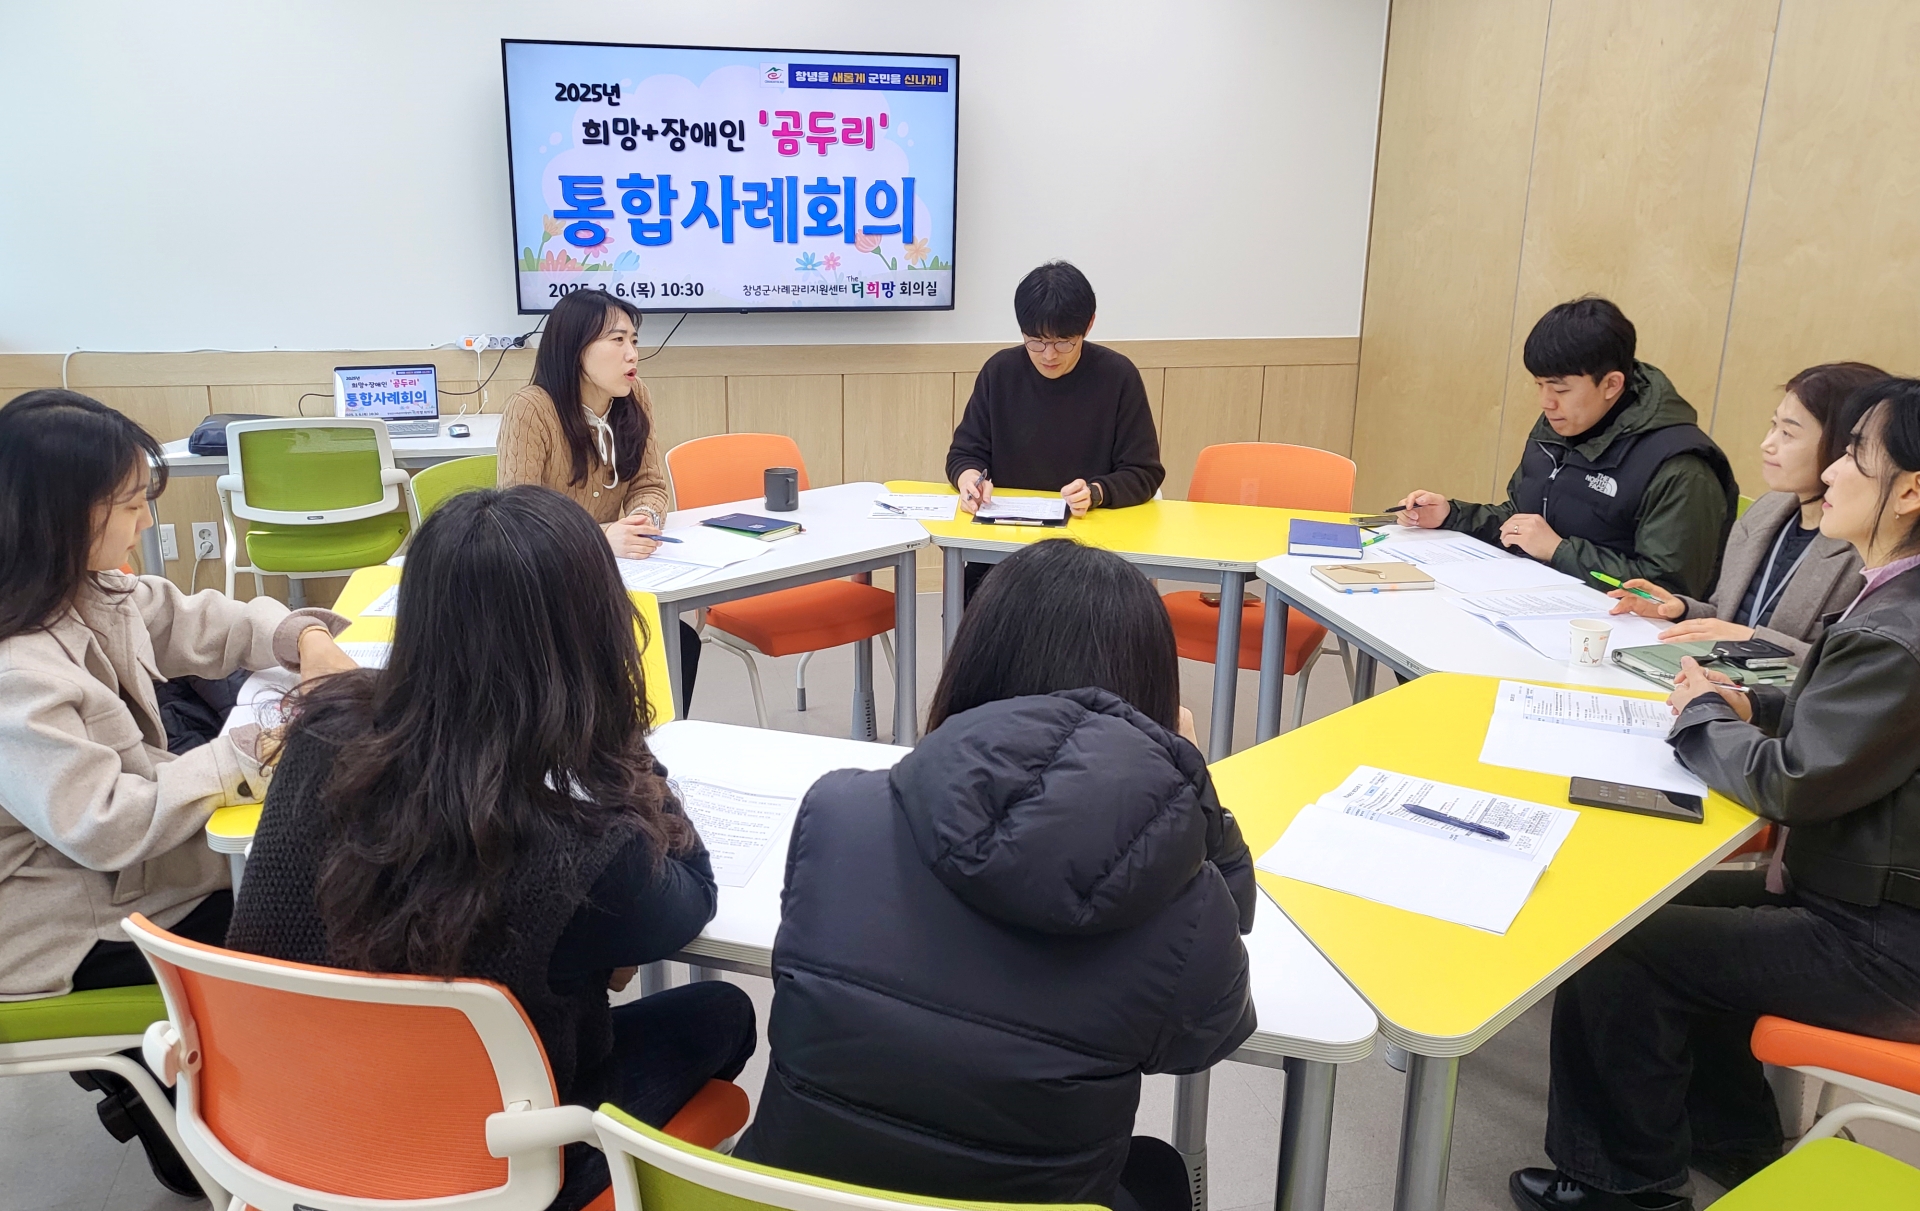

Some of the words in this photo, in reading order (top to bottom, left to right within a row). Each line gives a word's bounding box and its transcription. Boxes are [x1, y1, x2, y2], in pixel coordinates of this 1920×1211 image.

[795, 70, 829, 83] 창녕을
[831, 71, 866, 85] 새롭게
[868, 73, 901, 85] 군민을
[904, 73, 943, 87] 신나게!
[554, 82, 621, 107] 2025년
[582, 117, 746, 152] 희망+장애인
[758, 109, 889, 157] '곰두리'
[553, 172, 916, 248] 통합사례회의
[846, 275, 858, 283] The
[615, 281, 656, 299] 6.(목)
[660, 282, 704, 297] 10:30
[742, 283, 848, 297] 창녕군사례관리지원센터
[851, 281, 896, 298] 더희망
[899, 281, 938, 297] 회의실
[345, 390, 427, 408] 통합사례회의
[1584, 474, 1608, 487] NORTH
[1596, 472, 1610, 482] THE
[1588, 482, 1606, 493] FACE
